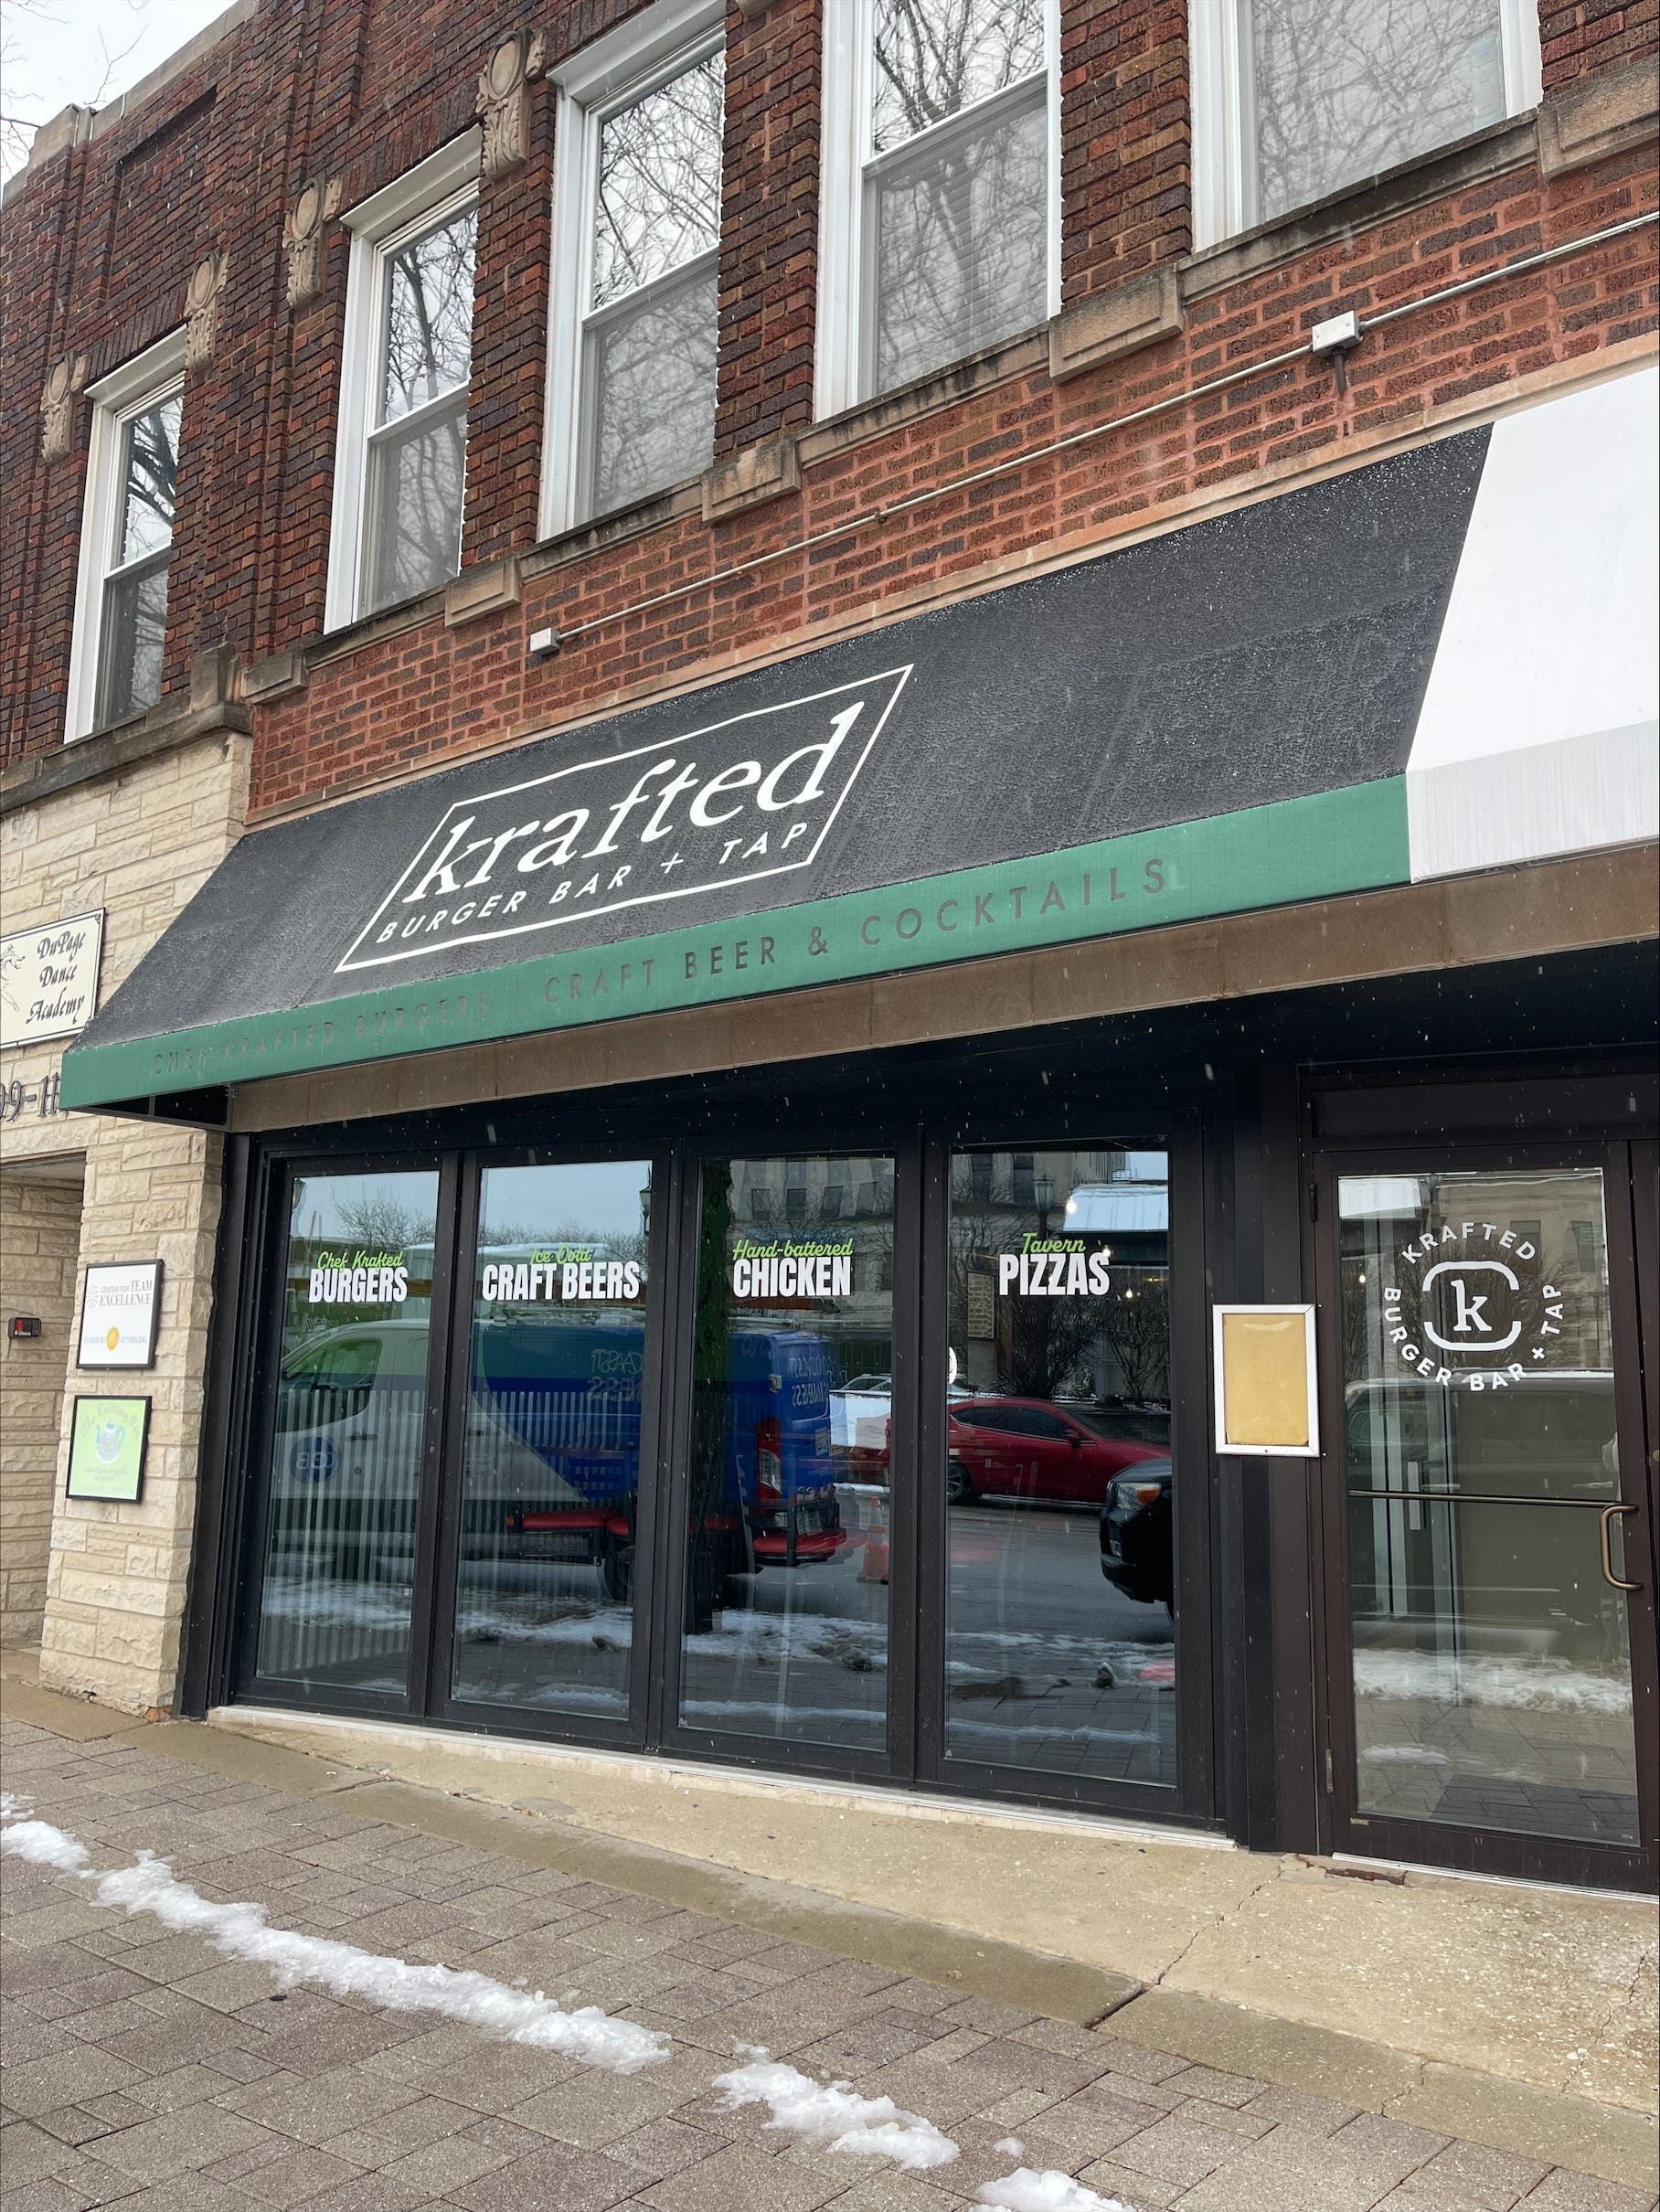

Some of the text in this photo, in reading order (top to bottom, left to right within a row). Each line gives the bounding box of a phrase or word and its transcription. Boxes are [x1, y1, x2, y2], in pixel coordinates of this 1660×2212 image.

[401, 700, 866, 903] krafted
[376, 889, 527, 944] BURGER
[548, 865, 627, 905] BAR
[718, 822, 808, 865] TAP
[37, 931, 86, 962] DuPage
[355, 991, 491, 1039] BURGERS
[545, 958, 656, 1004] CRAFT
[685, 936, 775, 979] BEER
[807, 926, 828, 955] &
[860, 858, 1166, 946] COCKTAILS
[39, 964, 78, 988] Dance
[26, 986, 85, 1025] Academy
[317, 1250, 403, 1271] Chef Krafted
[529, 1244, 592, 1265] Ice Cold
[732, 1238, 854, 1260] Hand-battered
[1020, 1232, 1086, 1255] Tavern
[1401, 1221, 1536, 1265] KRAFTED
[131, 1279, 153, 1292] TEAM
[308, 1267, 408, 1303] BURGERS
[482, 1261, 641, 1301] CRAFT BEERS
[733, 1256, 852, 1297] CHICKEN
[998, 1251, 1110, 1296] PIZZAS
[99, 1292, 152, 1307] EXCELLENCE
[1450, 1279, 1493, 1332] k
[1383, 1287, 1452, 1387] BURGER
[1469, 1362, 1527, 1391] BAR
[1540, 1283, 1564, 1335] TAP
